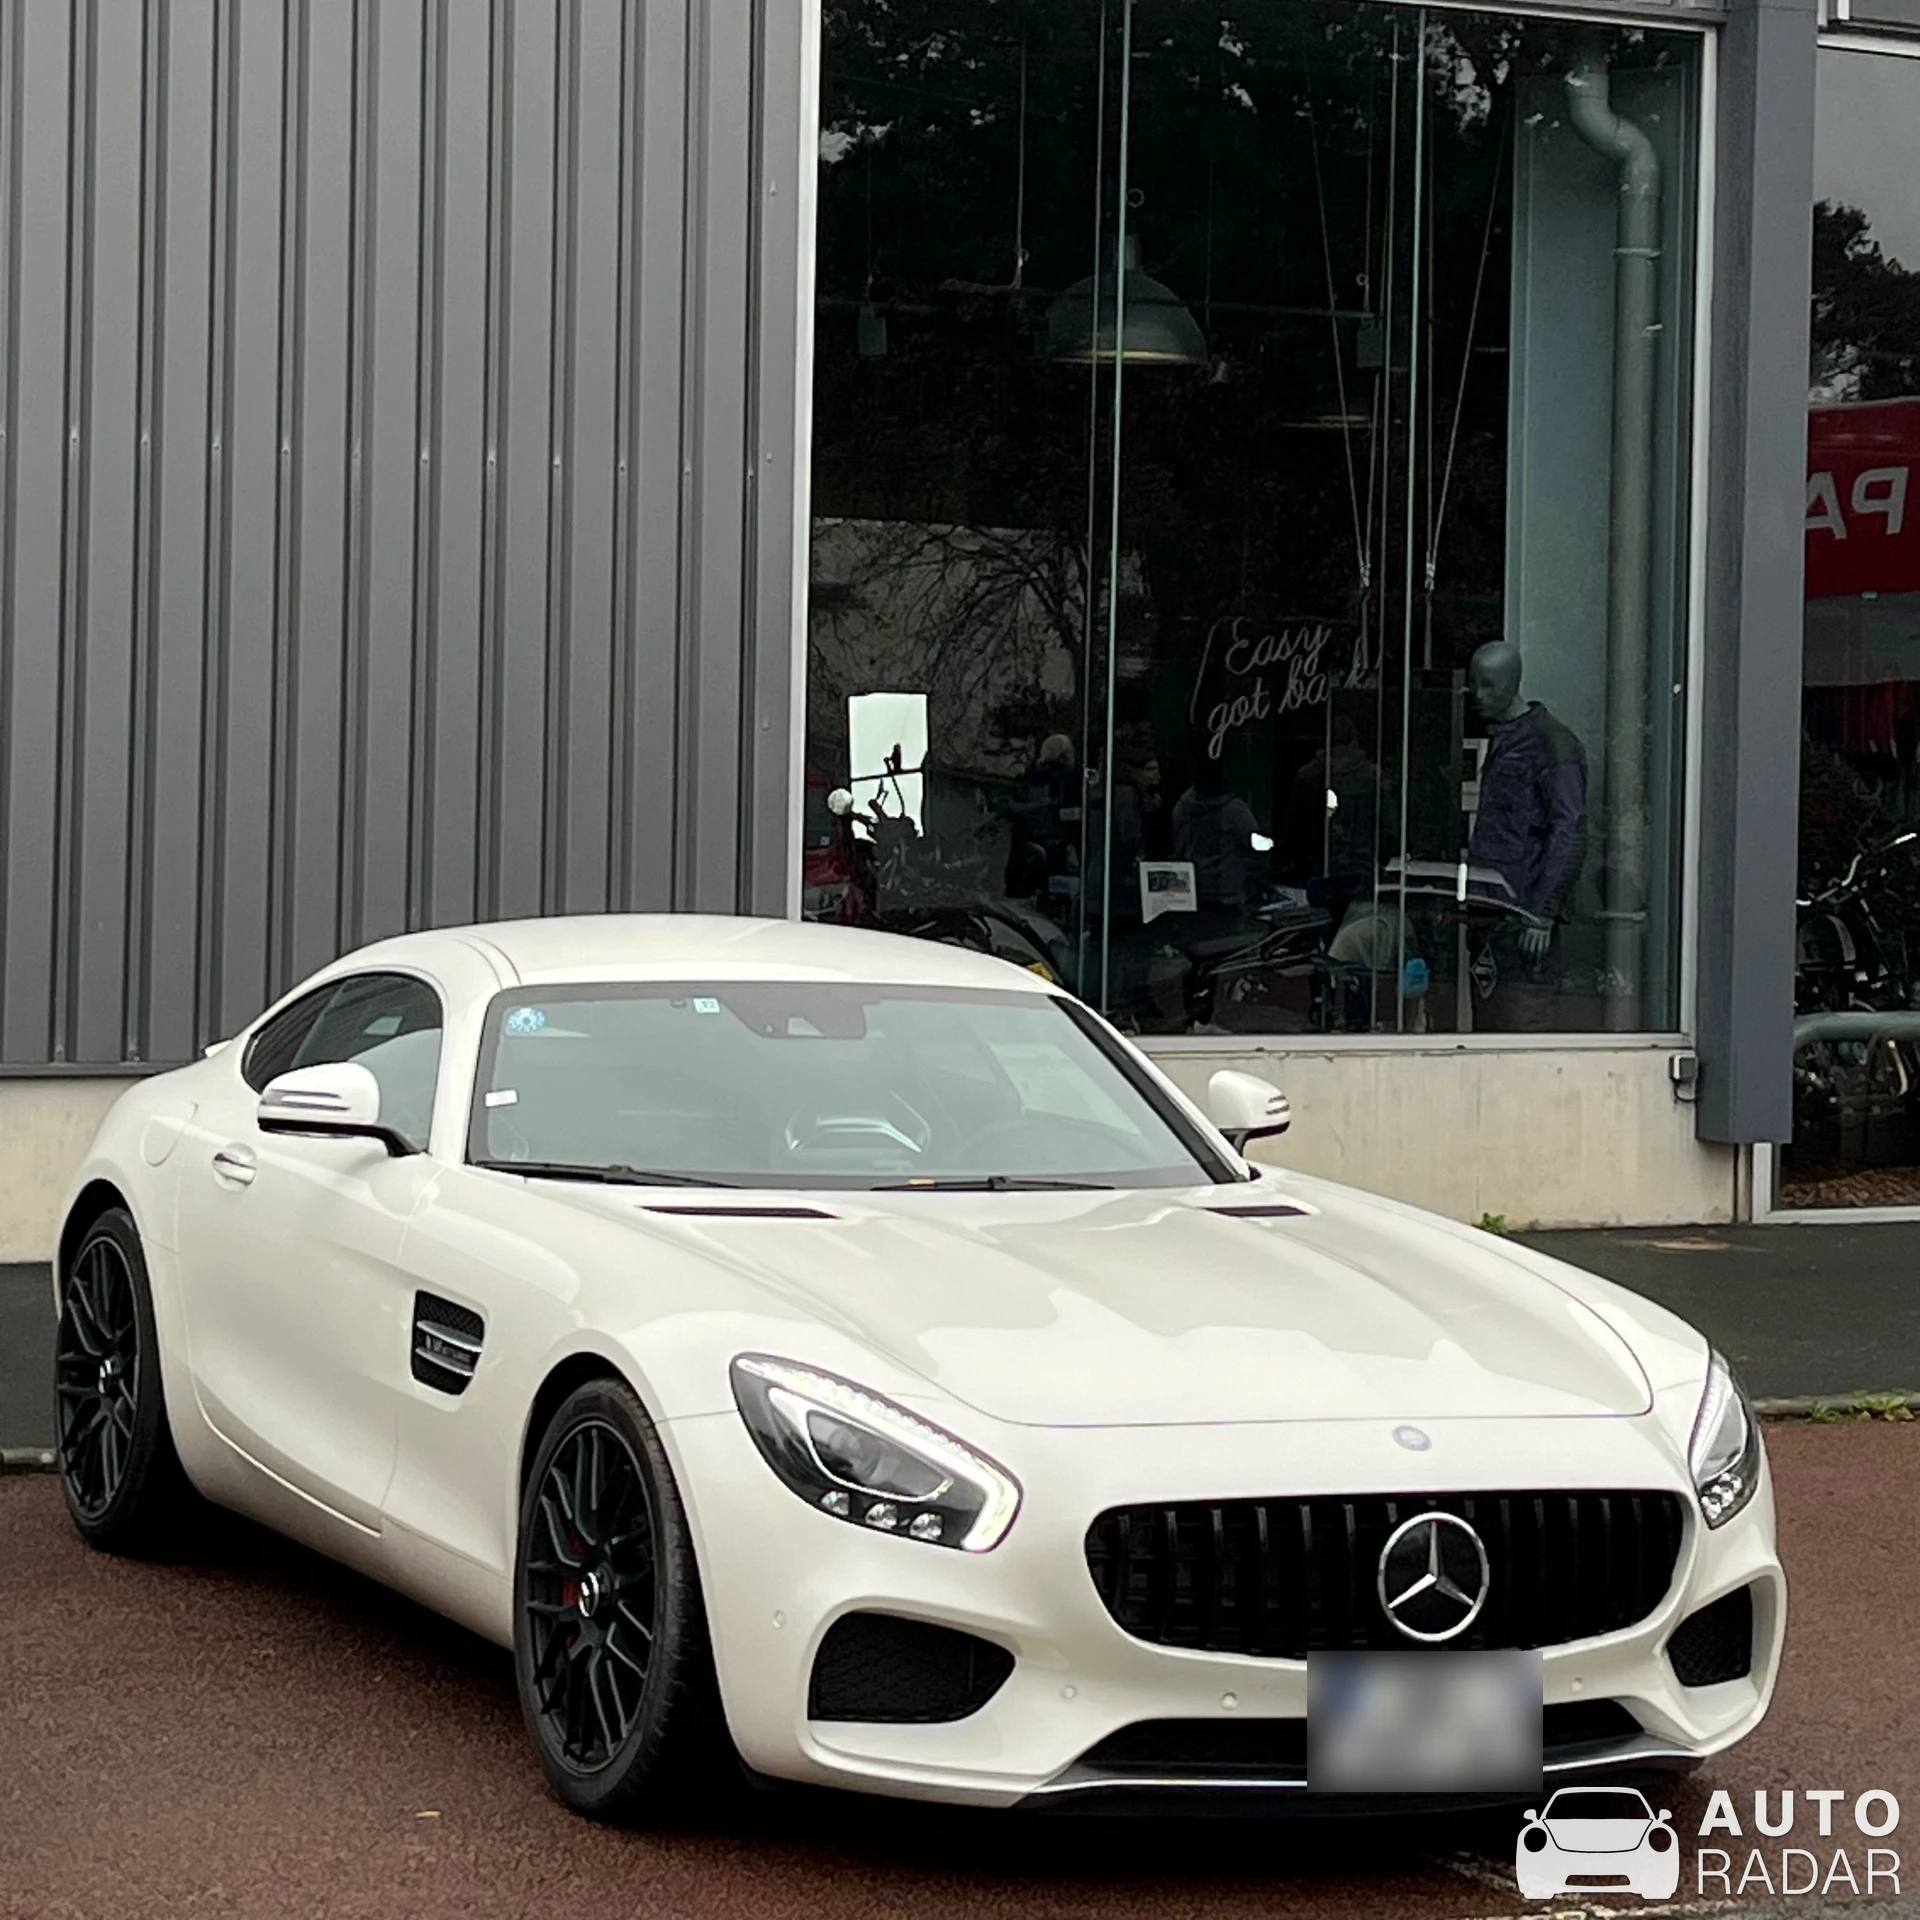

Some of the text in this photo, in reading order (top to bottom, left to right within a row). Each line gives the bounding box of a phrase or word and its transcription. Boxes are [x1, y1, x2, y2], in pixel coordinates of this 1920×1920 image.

[1225, 616, 1332, 677] Easy
[1207, 636, 1368, 760] got bak
